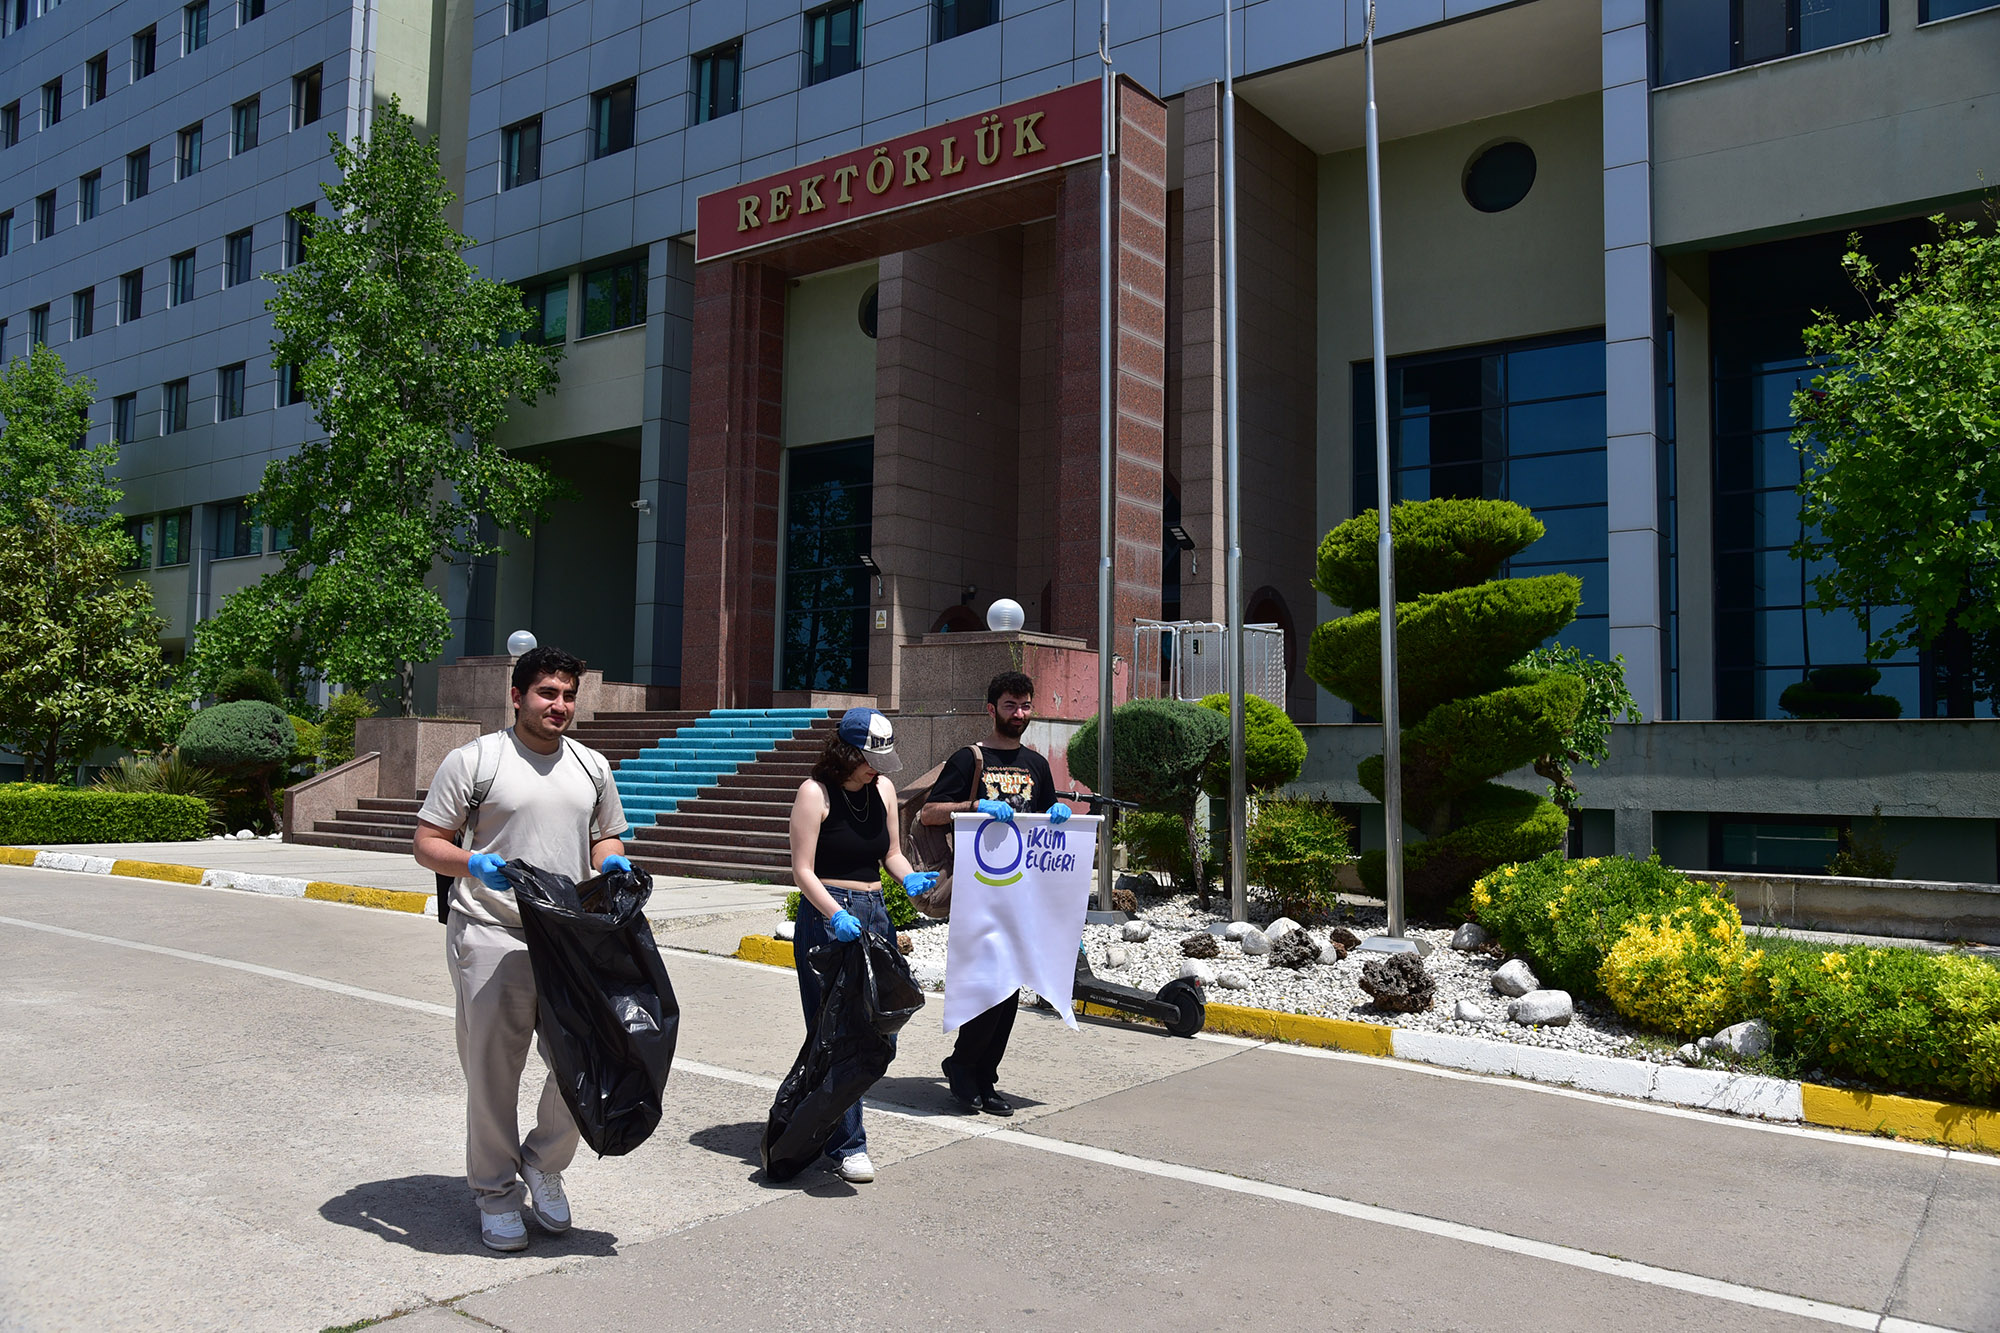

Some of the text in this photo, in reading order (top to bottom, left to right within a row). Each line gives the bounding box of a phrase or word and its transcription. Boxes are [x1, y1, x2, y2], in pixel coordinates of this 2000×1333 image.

[736, 111, 1047, 232] REKTÖRLÜK
[870, 735, 886, 749] NEW
[985, 772, 1028, 785] AUTISTIC
[1000, 784, 1021, 794] GAY
